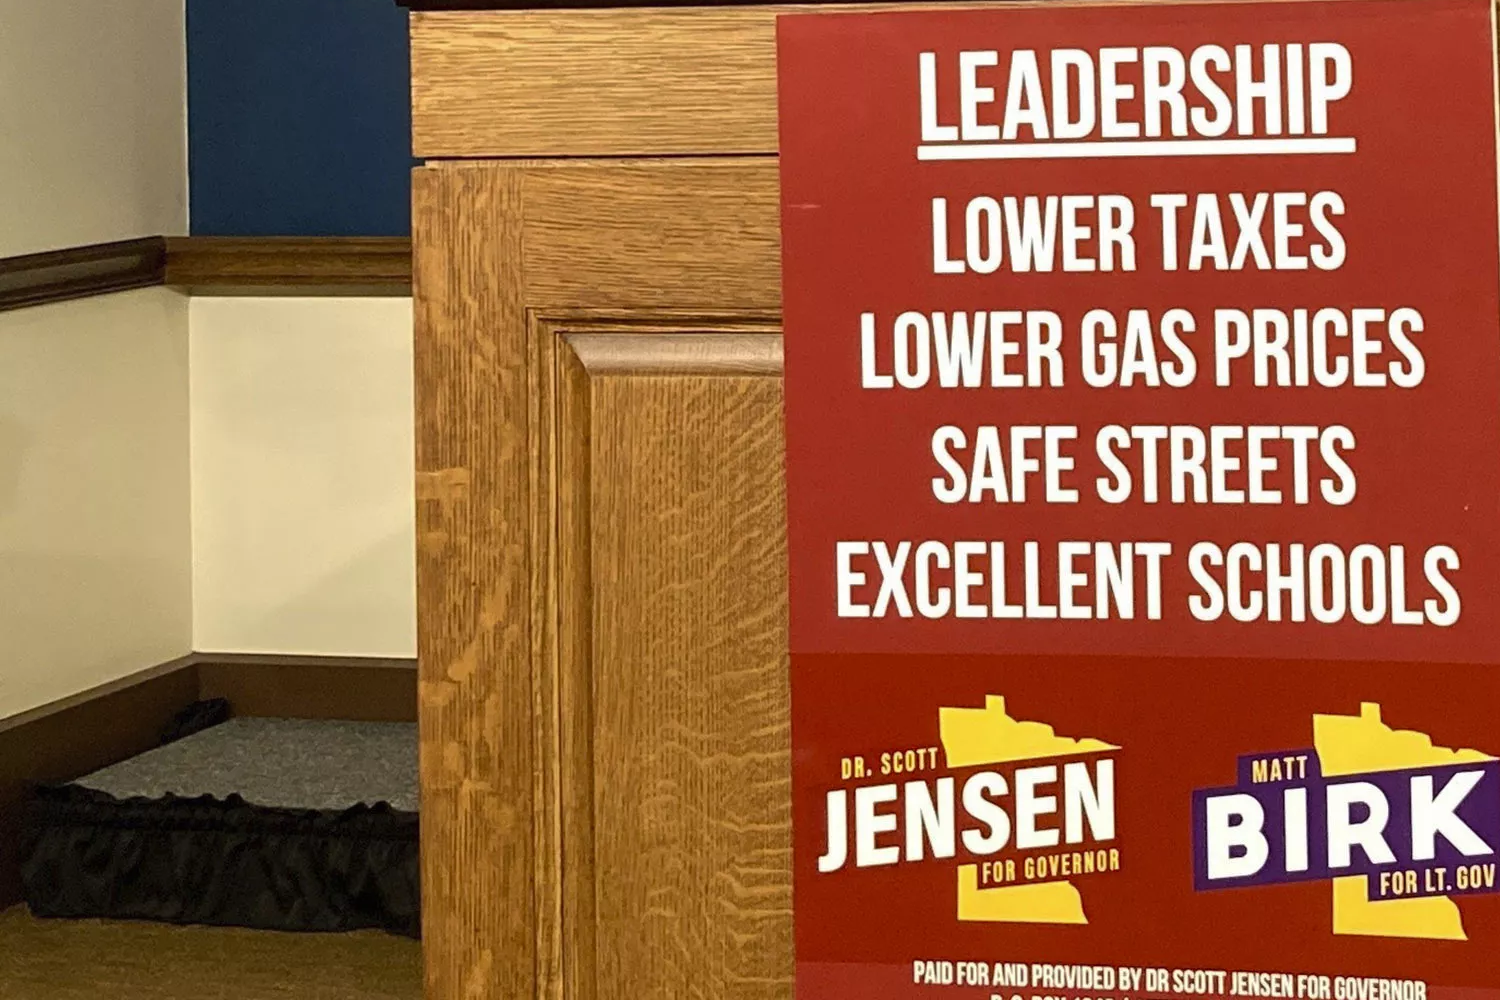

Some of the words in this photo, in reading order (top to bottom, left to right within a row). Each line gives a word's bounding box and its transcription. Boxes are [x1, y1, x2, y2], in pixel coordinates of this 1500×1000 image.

[919, 42, 1355, 142] LEADERSHIP
[932, 194, 1137, 274] LOWER
[1150, 190, 1347, 271] TAXES
[860, 310, 1065, 389] LOWER
[1080, 308, 1197, 388] GAS
[1214, 307, 1426, 388] PRICES
[931, 425, 1079, 504] SAFE
[1095, 425, 1357, 506] STREETS
[836, 541, 1172, 620] EXCELLENT
[1188, 542, 1461, 627] SCHOOLS
[841, 756, 873, 780] DR.
[881, 747, 939, 775] SCOTT
[1251, 755, 1308, 784] MATT
[818, 759, 1116, 873] JENSEN
[1206, 770, 1495, 880] BIRK
[982, 860, 1016, 884] FOR
[1024, 849, 1120, 879] GOVERNOR
[1380, 869, 1418, 896] FOR
[1425, 867, 1453, 892] LT.
[1456, 863, 1496, 889] GOV
[913, 960, 953, 985] PAID
[956, 961, 990, 987] FOR
[992, 962, 1028, 988] AND
[1031, 963, 1116, 990] PROVIDED
[1118, 966, 1143, 991] BY
[1145, 967, 1170, 993] DR
[1172, 969, 1227, 995] SCOTT
[1229, 971, 1294, 999] JENSEN
[1297, 974, 1331, 1000] FOR
[1333, 976, 1427, 1000] GOVERNOR
